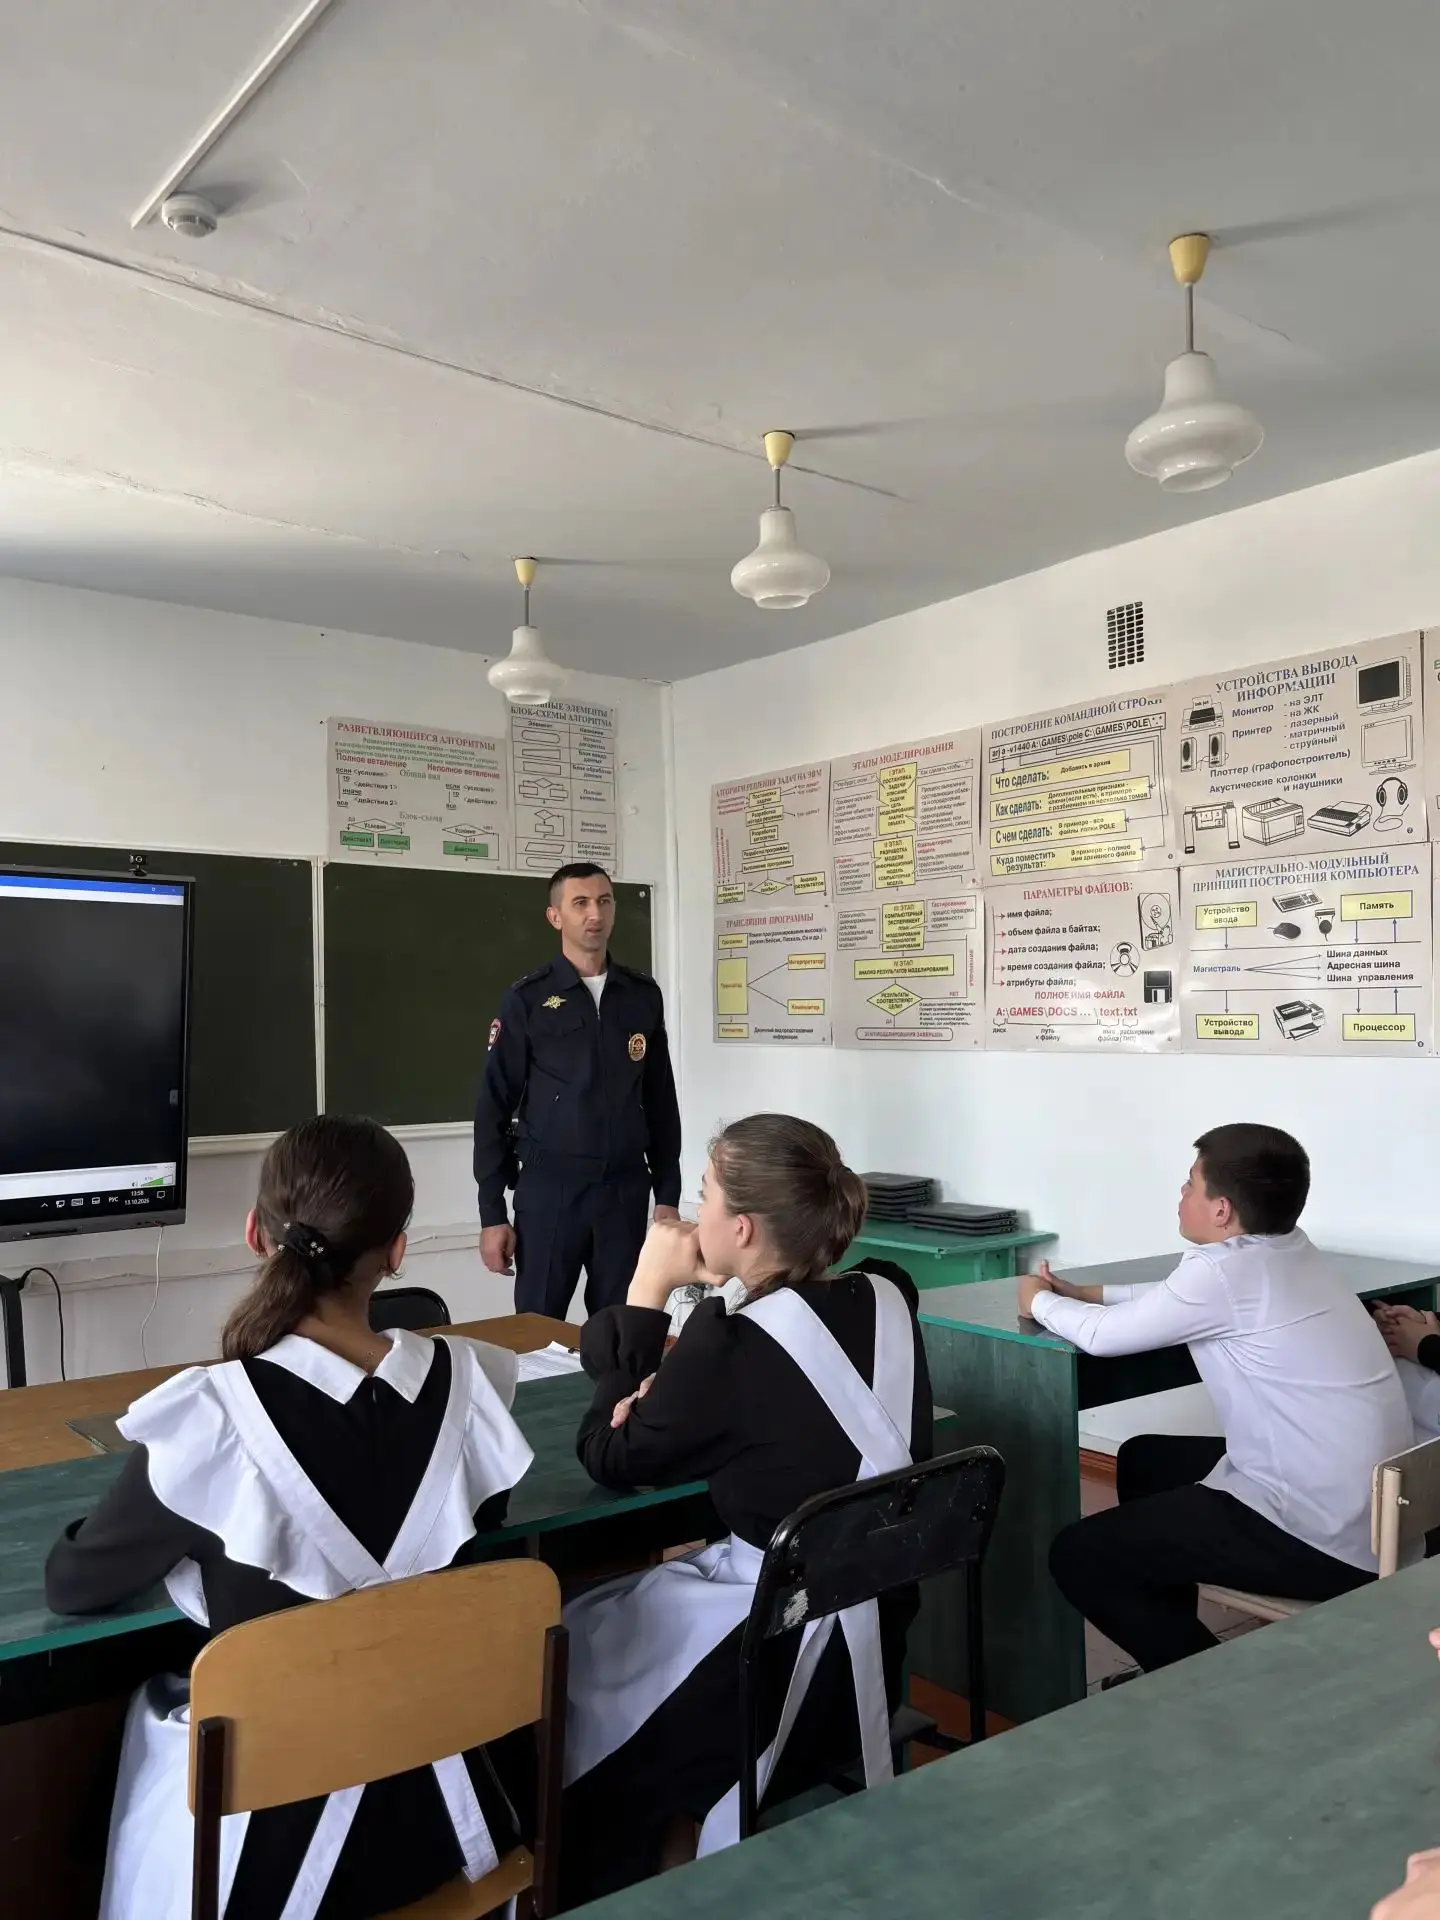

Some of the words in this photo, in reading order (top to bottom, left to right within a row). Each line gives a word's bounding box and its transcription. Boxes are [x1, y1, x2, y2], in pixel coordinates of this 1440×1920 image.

[1215, 667, 1299, 694] УСТРОЙСТВА
[1301, 654, 1358, 676] ВЫВОДА
[1237, 672, 1336, 702] ИНФОРМАЦИИ
[1304, 693, 1324, 703] ЭЛТ
[510, 706, 566, 719] БЛОК-СХЕМЫ
[568, 715, 613, 727] АЛГОРИТМА
[1232, 704, 1274, 717] Монитор
[1303, 705, 1319, 714] ЖК
[991, 718, 1053, 739] ПОСТРОЕНИЕ
[1054, 701, 1117, 726] КОМАНДНОЙ
[1290, 713, 1339, 728] лазерный
[337, 722, 438, 743] РАЗВЕТВЛЯЮЩИЕСЯ
[439, 735, 495, 751] АЛГОРИТМЫ
[1232, 725, 1272, 739] Принтер
[1290, 723, 1346, 740] матричный
[1290, 736, 1338, 751] струйный
[336, 753, 365, 763] Полное
[367, 758, 407, 768] ветвление
[852, 758, 878, 771] ЭТАПЫ
[880, 741, 954, 765] МОДЕЛИРОВАНИЯ
[1060, 763, 1088, 774] Добавить
[1093, 760, 1111, 769] архив
[1210, 766, 1249, 778] Плоттер
[1252, 749, 1351, 773] (графопостроитель)
[428, 763, 462, 774] Неполное
[464, 769, 500, 779] ветвление
[995, 775, 1010, 789] Что
[1011, 770, 1050, 787] сделать:
[1209, 778, 1273, 793] Акустические
[1276, 772, 1317, 784] колонки
[1283, 784, 1290, 792] и
[1292, 777, 1343, 791] наушники
[995, 803, 1008, 816] Как
[1009, 800, 1042, 815] сделать:
[996, 831, 1001, 843] С
[1002, 830, 1018, 842] чем
[1018, 826, 1052, 841] сделать:
[996, 855, 1015, 865] Куда
[1015, 851, 1055, 862] поместить
[1116, 850, 1136, 858] файла
[1006, 861, 1046, 873] результат:
[1215, 852, 1390, 879] МАГИСТРАЛЬНО-МОДУЛЬНЫЙ
[1192, 875, 1248, 892] ПРИНЦИП
[1250, 870, 1328, 888] ПОСТРОЕНИЯ
[1330, 864, 1419, 882] КОМПЬЮТЕРА
[1023, 886, 1083, 900] ПАРАМЕТРЫ
[1085, 882, 1133, 893] ФАЙЛОВ:
[1024, 908, 1052, 918] файла;
[1203, 905, 1250, 916] Устройство
[1359, 901, 1394, 911] Память
[769, 913, 814, 924] ПРОГРАММЫ
[1213, 916, 1239, 924] ввода
[1007, 928, 1033, 937] объем
[1035, 926, 1061, 936] файла
[1068, 925, 1100, 933] байтах;
[1008, 946, 1027, 955] дата
[1028, 944, 1066, 953] создания
[1068, 943, 1098, 952] файла;
[1326, 949, 1352, 958] Шина
[1353, 948, 1388, 958] данных
[1007, 963, 1032, 971] время
[1033, 962, 1073, 970] создания
[1075, 961, 1106, 971] файла;
[1193, 965, 1241, 974] Магистраль
[1327, 961, 1372, 971] Адресная
[1373, 960, 1401, 968] шина
[1006, 978, 1045, 988] атрибуты
[1046, 977, 1076, 987] файла;
[1326, 974, 1352, 982] Шина
[1357, 973, 1414, 982] управления
[1034, 991, 1070, 1000] ПОЛНОЕ
[1093, 988, 1125, 999] ФАЙЛА
[1203, 1018, 1254, 1028] Устройство
[1353, 1023, 1406, 1033] Процессор
[1213, 1028, 1245, 1036] вывода
